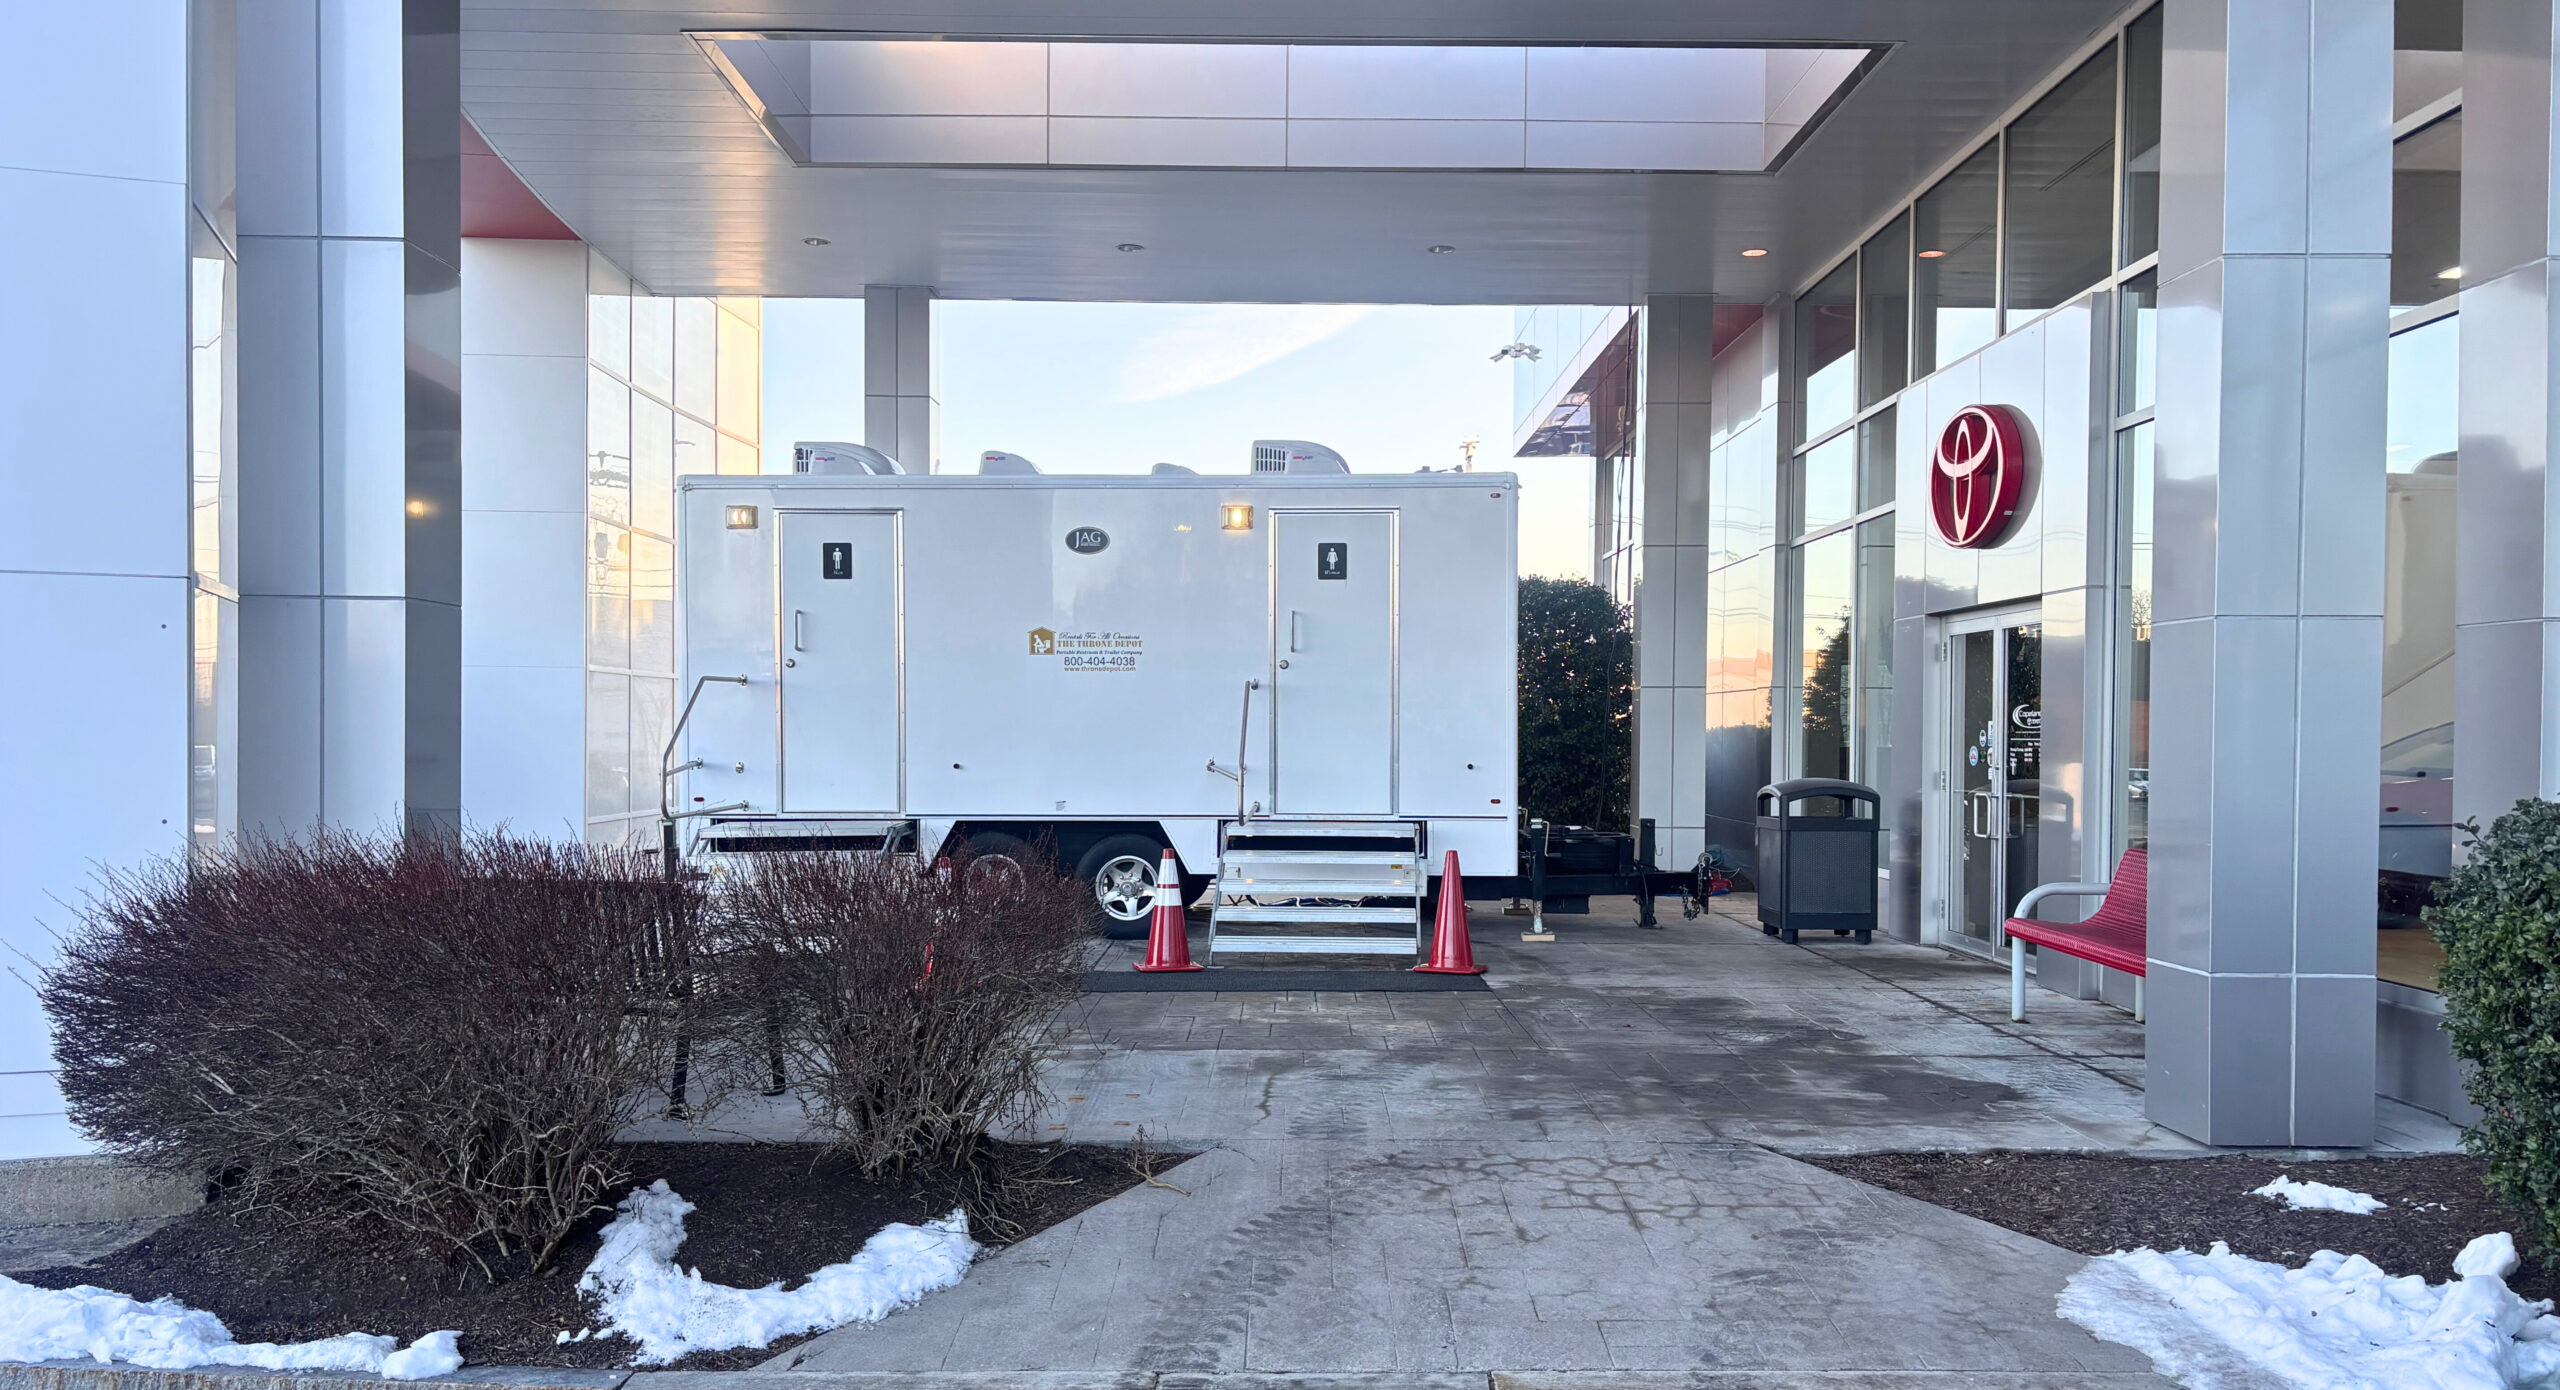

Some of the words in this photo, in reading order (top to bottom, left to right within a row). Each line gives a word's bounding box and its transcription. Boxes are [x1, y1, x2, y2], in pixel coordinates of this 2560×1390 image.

[1074, 531, 1101, 549] JAG
[1084, 632, 1096, 640] For
[1057, 640, 1075, 648] THE
[1077, 640, 1113, 648] THRONE
[1115, 640, 1143, 648] DEPOT
[1064, 656, 1136, 666] 800-404-4038
